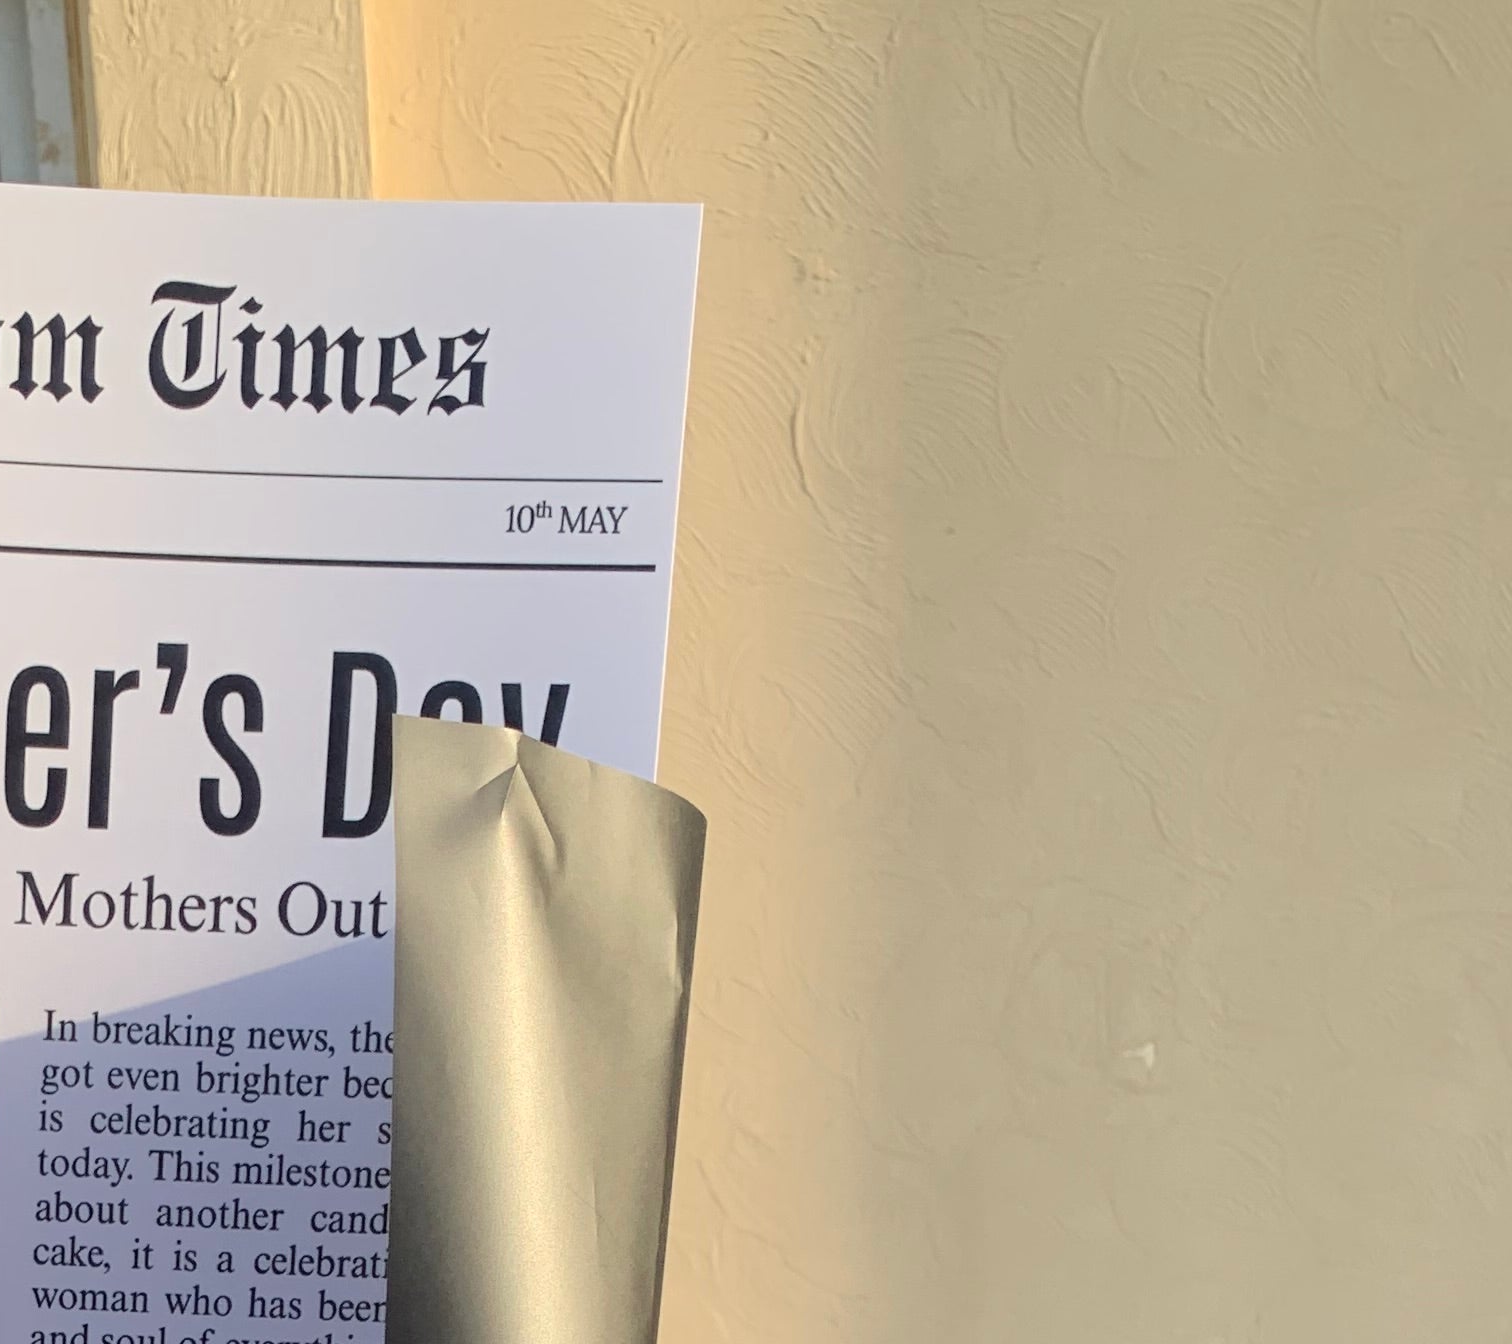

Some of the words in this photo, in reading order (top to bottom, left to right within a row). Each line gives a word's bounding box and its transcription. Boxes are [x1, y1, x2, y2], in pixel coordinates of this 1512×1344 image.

[149, 281, 490, 416] Times
[558, 506, 628, 534] MAY
[15, 871, 257, 934] Mothers
[278, 882, 388, 939] Out
[43, 1010, 78, 1042] In
[93, 1012, 235, 1057] breaking
[247, 1028, 335, 1058] news,
[41, 1061, 94, 1095] got
[108, 1068, 179, 1091] even
[197, 1061, 329, 1103] brighter
[39, 1100, 64, 1133] is
[91, 1104, 270, 1148] celebrating
[297, 1110, 351, 1142] her
[38, 1146, 132, 1187] today.
[149, 1150, 219, 1183] This
[231, 1154, 391, 1190] milestone
[35, 1191, 128, 1225] about
[156, 1198, 284, 1231] another
[33, 1236, 110, 1273] cake,
[132, 1238, 155, 1271] it
[173, 1240, 198, 1273] is
[217, 1252, 234, 1273] a
[32, 1288, 148, 1313] woman
[165, 1285, 232, 1316] who
[249, 1287, 301, 1319] has
